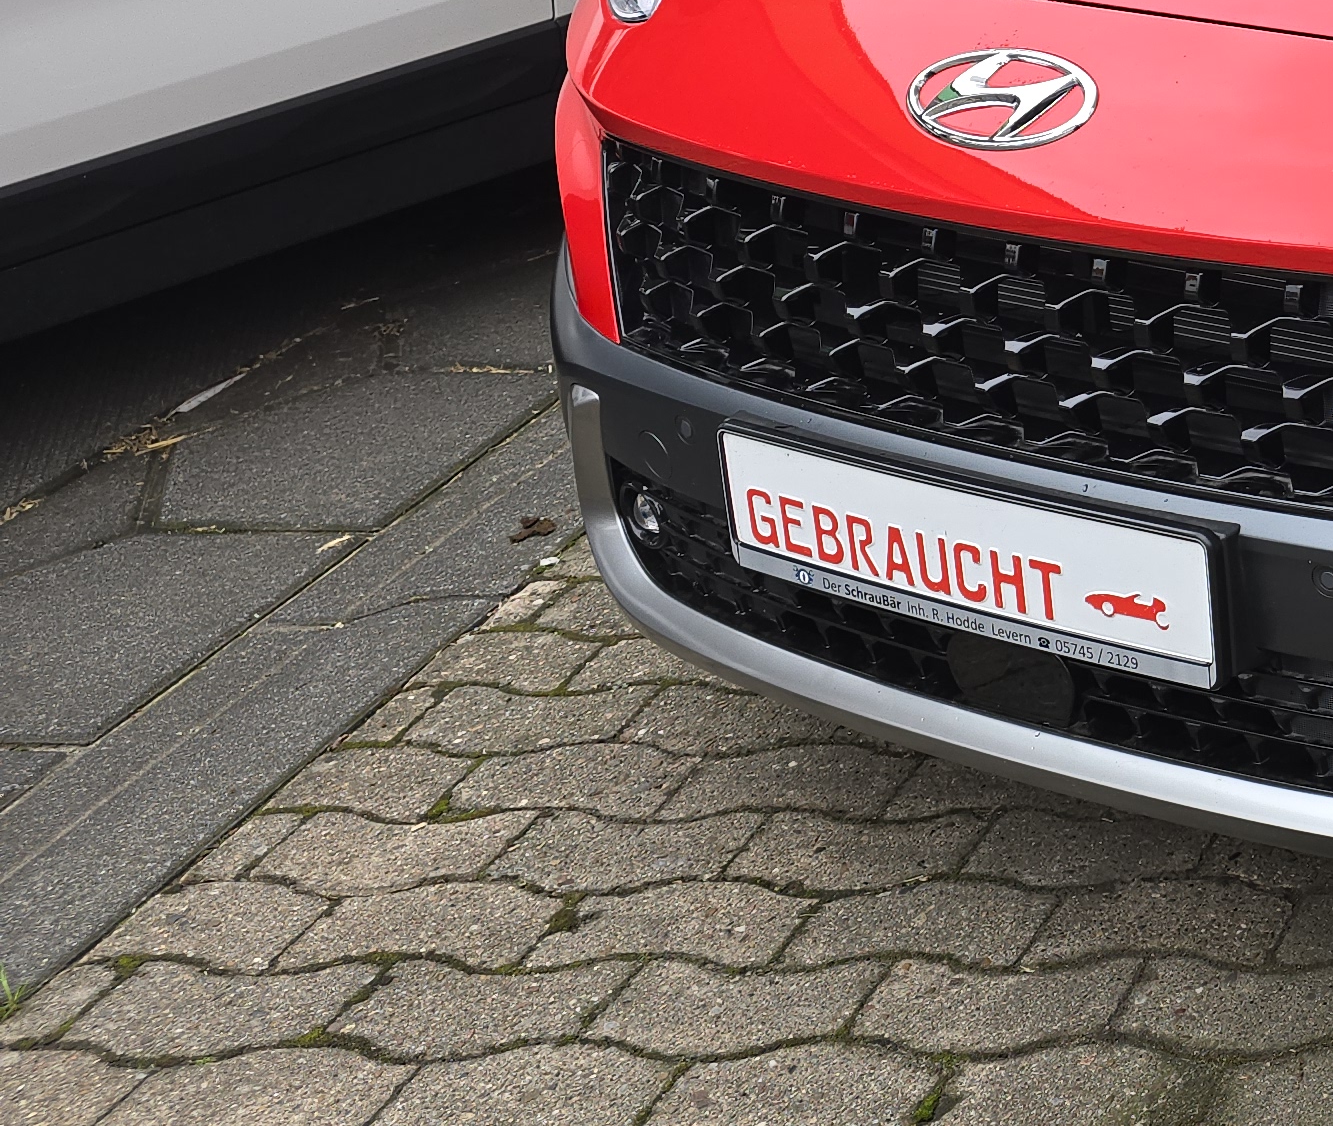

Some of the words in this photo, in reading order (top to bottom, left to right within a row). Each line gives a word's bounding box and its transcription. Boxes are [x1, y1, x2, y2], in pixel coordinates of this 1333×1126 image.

[745, 487, 1062, 621] GEBRAUCHT
[822, 577, 841, 594] Der
[844, 582, 903, 610] SchrauBär
[907, 601, 930, 619] Inh.
[931, 607, 944, 624] R.
[946, 612, 986, 633] Hodde
[991, 624, 1033, 646] Levern
[1055, 639, 1095, 660] 05745
[1107, 651, 1140, 671] 2129
